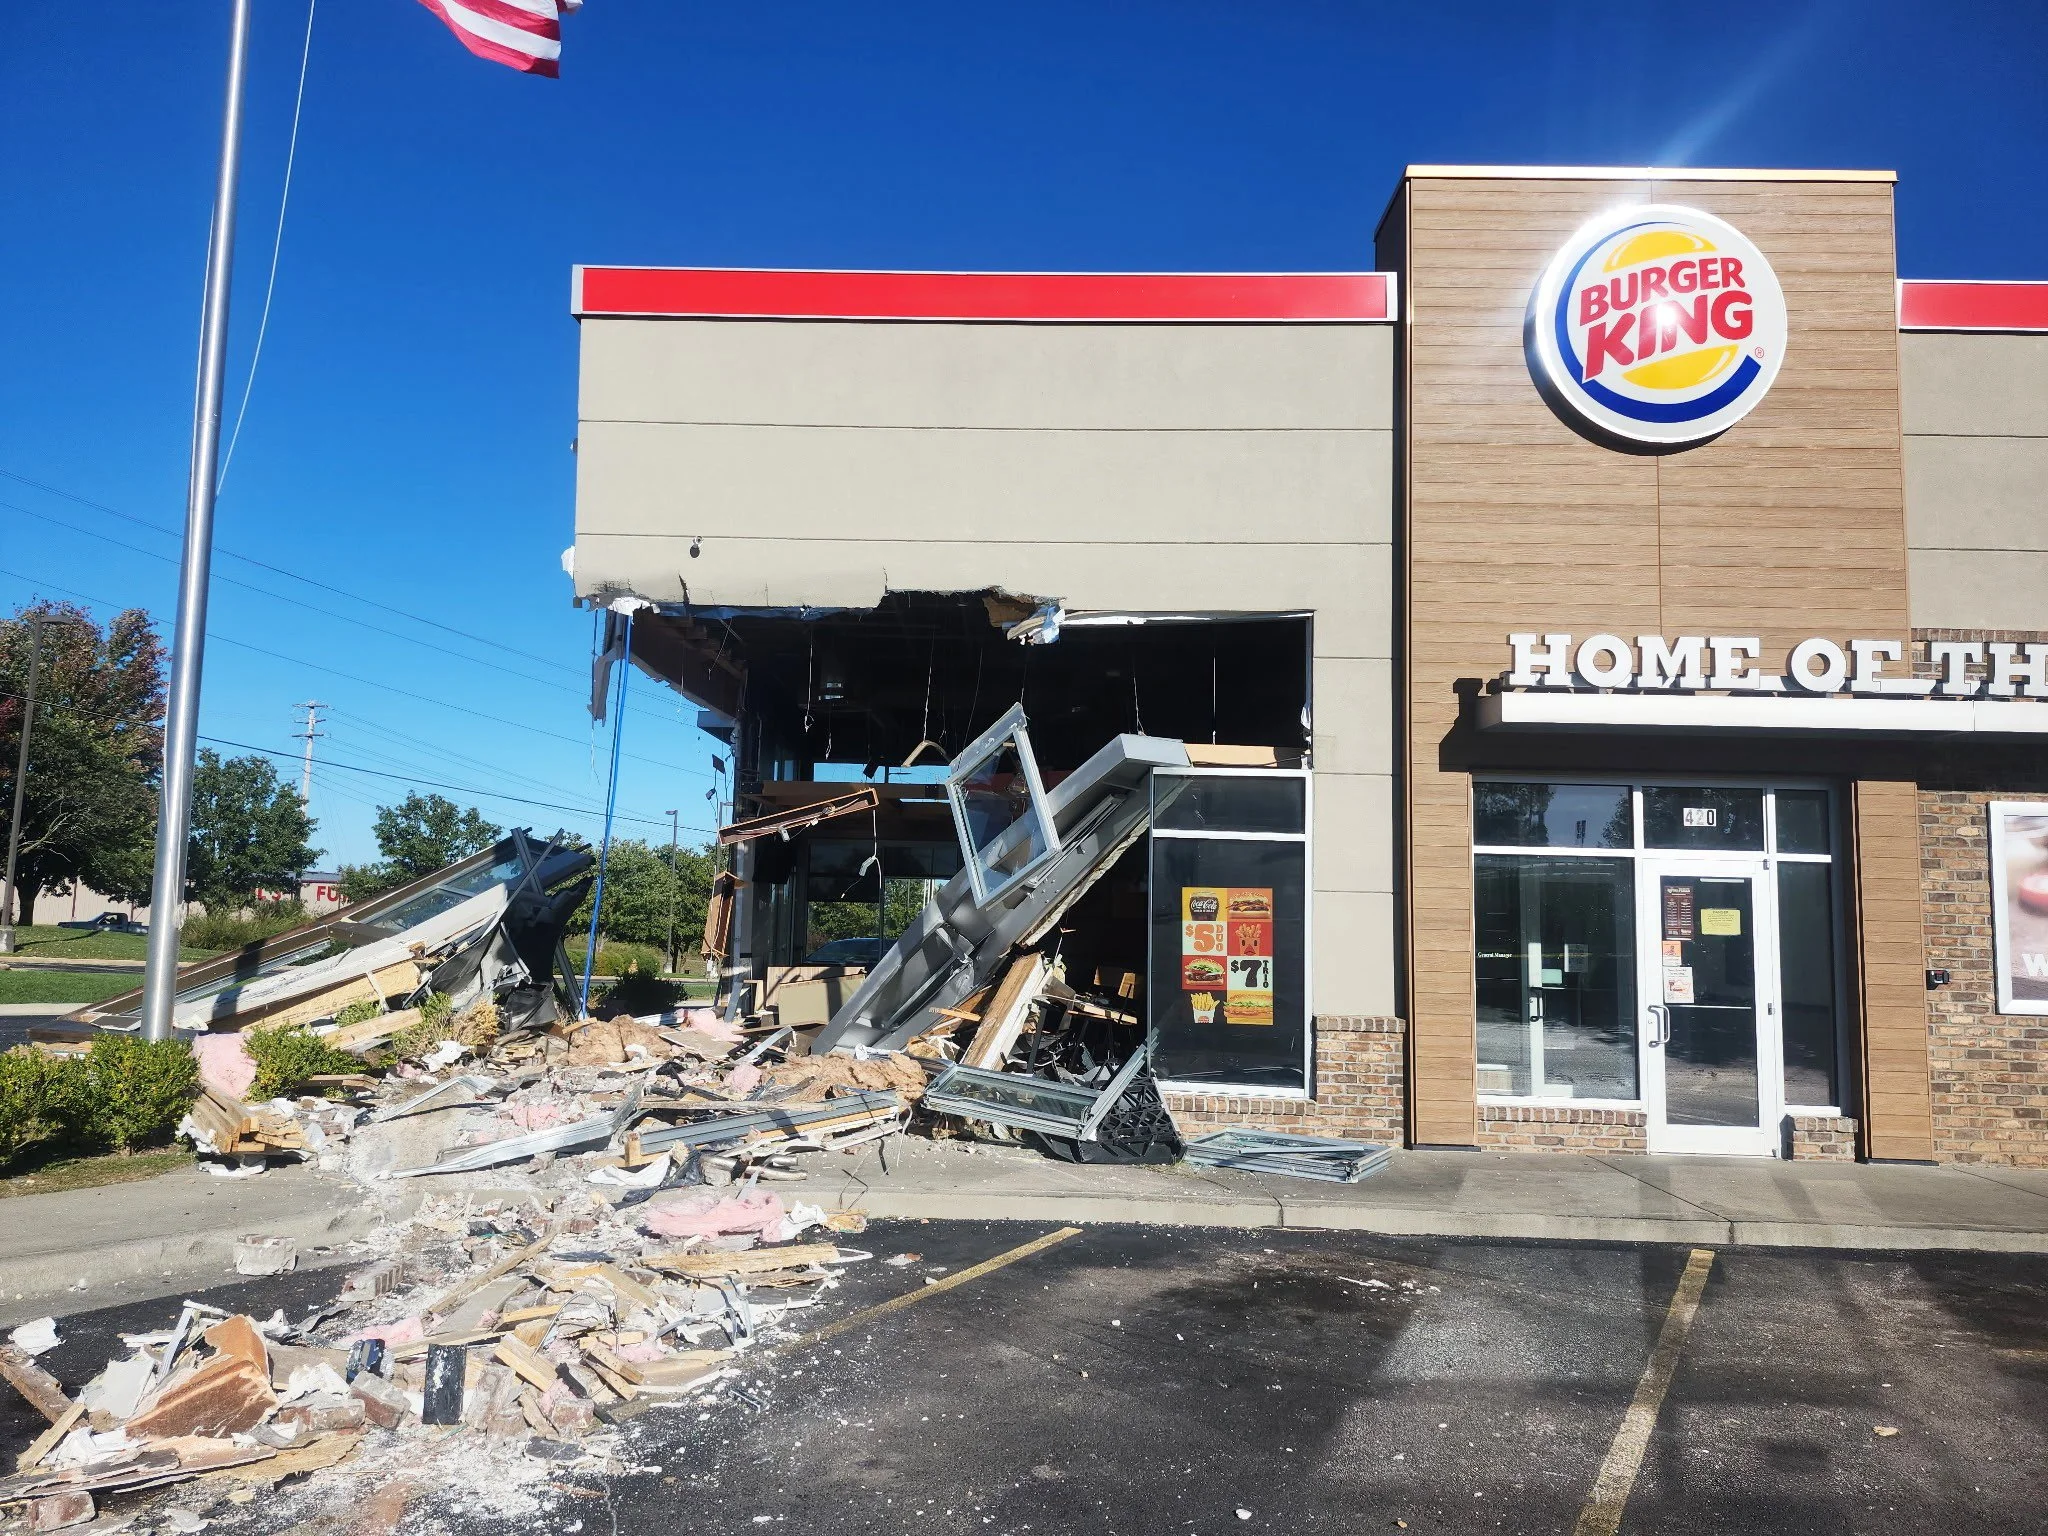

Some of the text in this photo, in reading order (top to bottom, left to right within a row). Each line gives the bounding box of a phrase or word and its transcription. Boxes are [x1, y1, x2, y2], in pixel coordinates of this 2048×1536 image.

[1580, 257, 1745, 326] BURGER
[1584, 290, 1753, 380] KING
[1509, 634, 1760, 688] HOME
[1791, 638, 1902, 692] OF
[1685, 809, 1714, 825] 420
[1185, 924, 1215, 952] $5
[1231, 959, 1262, 987] $7
